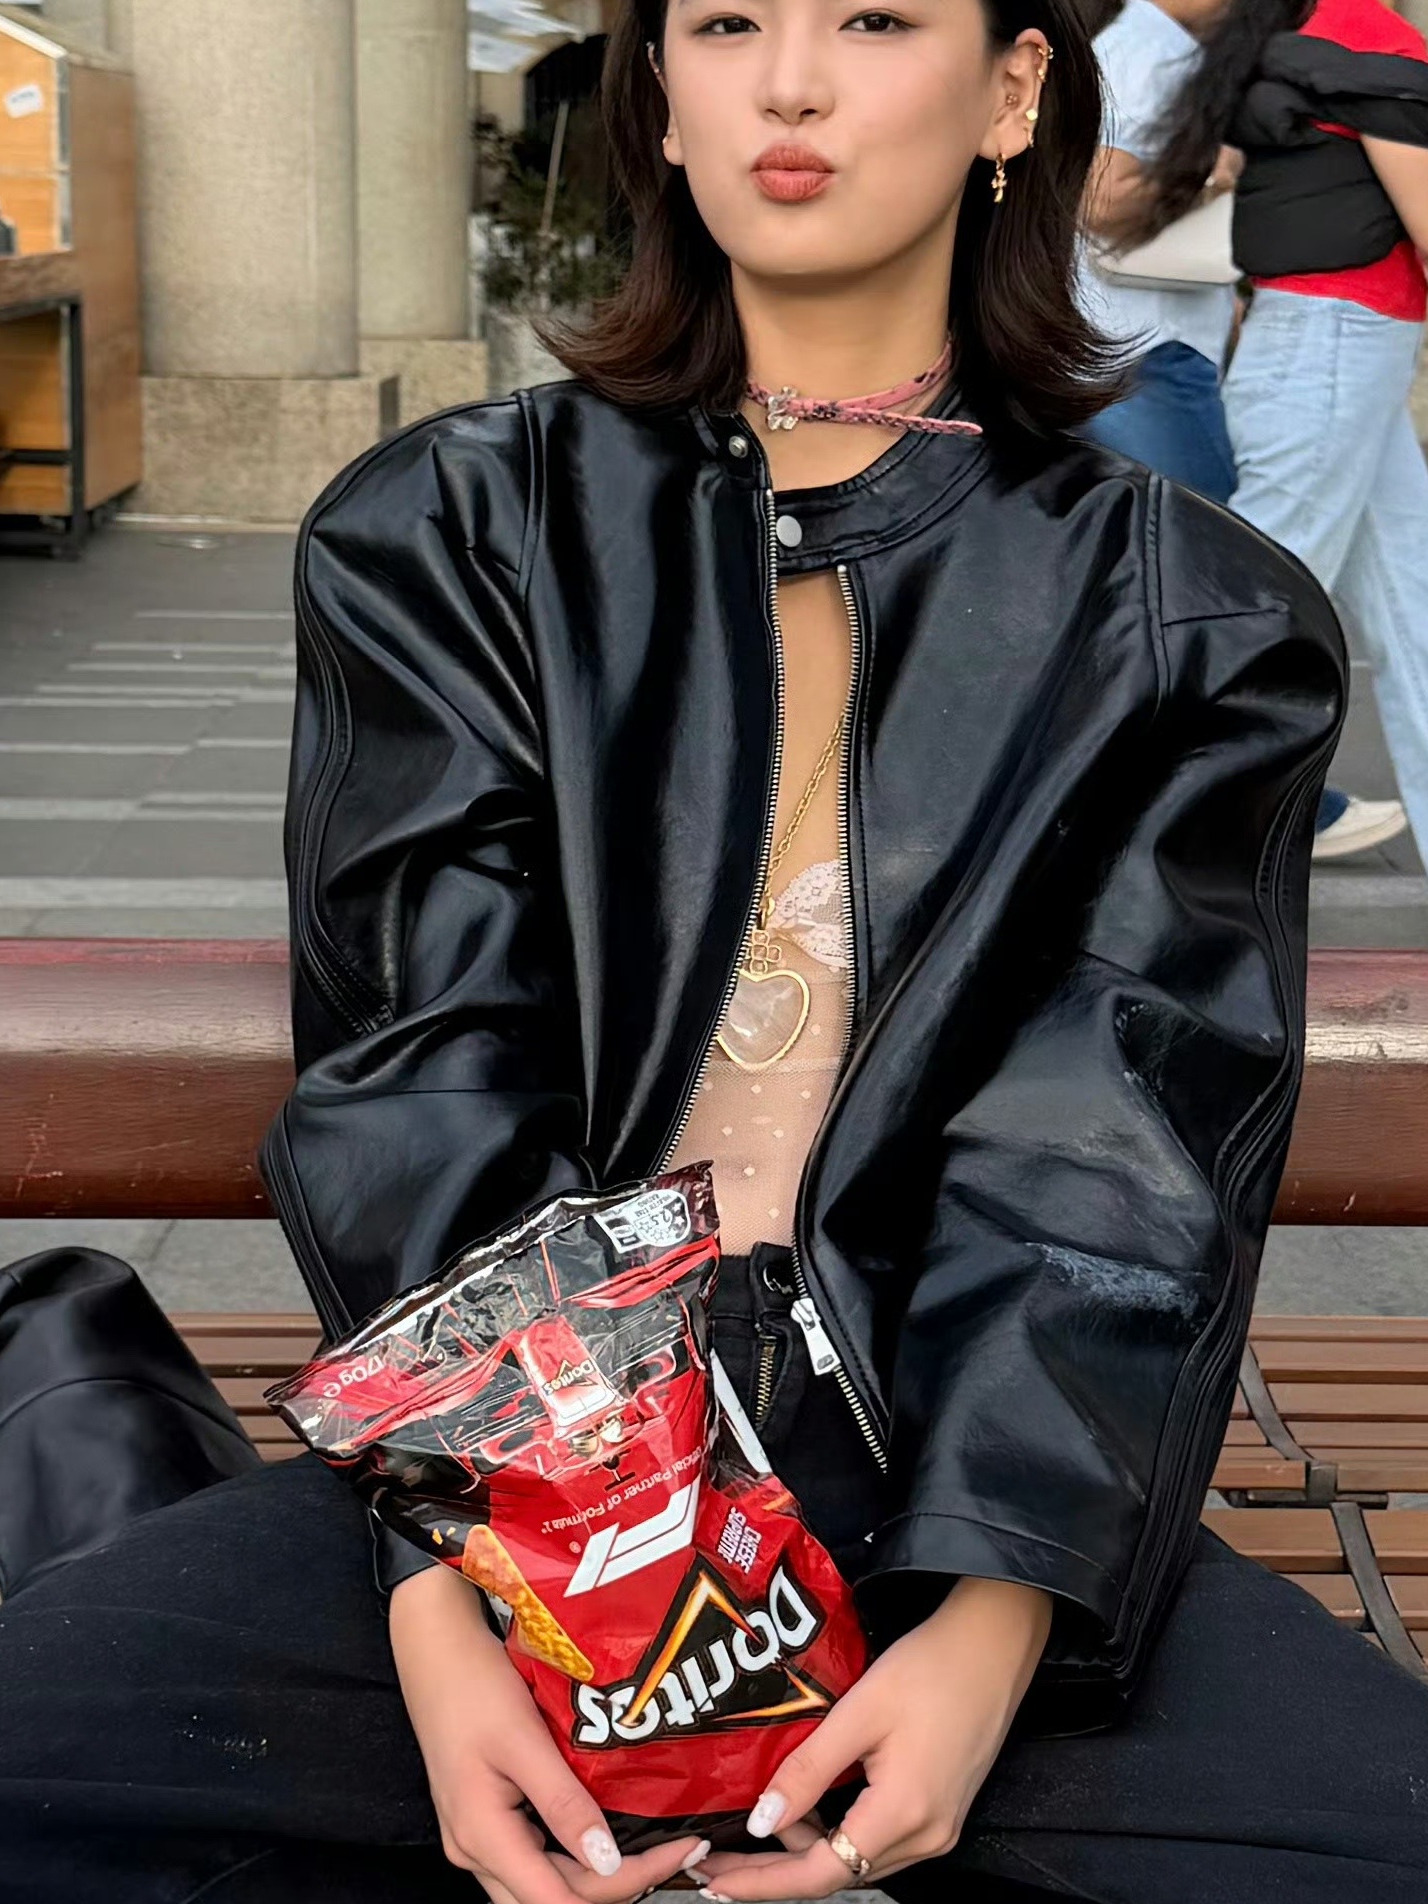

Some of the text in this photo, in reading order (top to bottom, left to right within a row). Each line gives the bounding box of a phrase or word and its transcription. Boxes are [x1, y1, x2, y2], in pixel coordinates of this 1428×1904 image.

[543, 1358, 594, 1396] Doritos
[623, 1471, 673, 1501] Partner
[552, 1502, 606, 1530] Formula
[606, 1493, 622, 1512] of
[576, 1564, 818, 1746] Doritos
